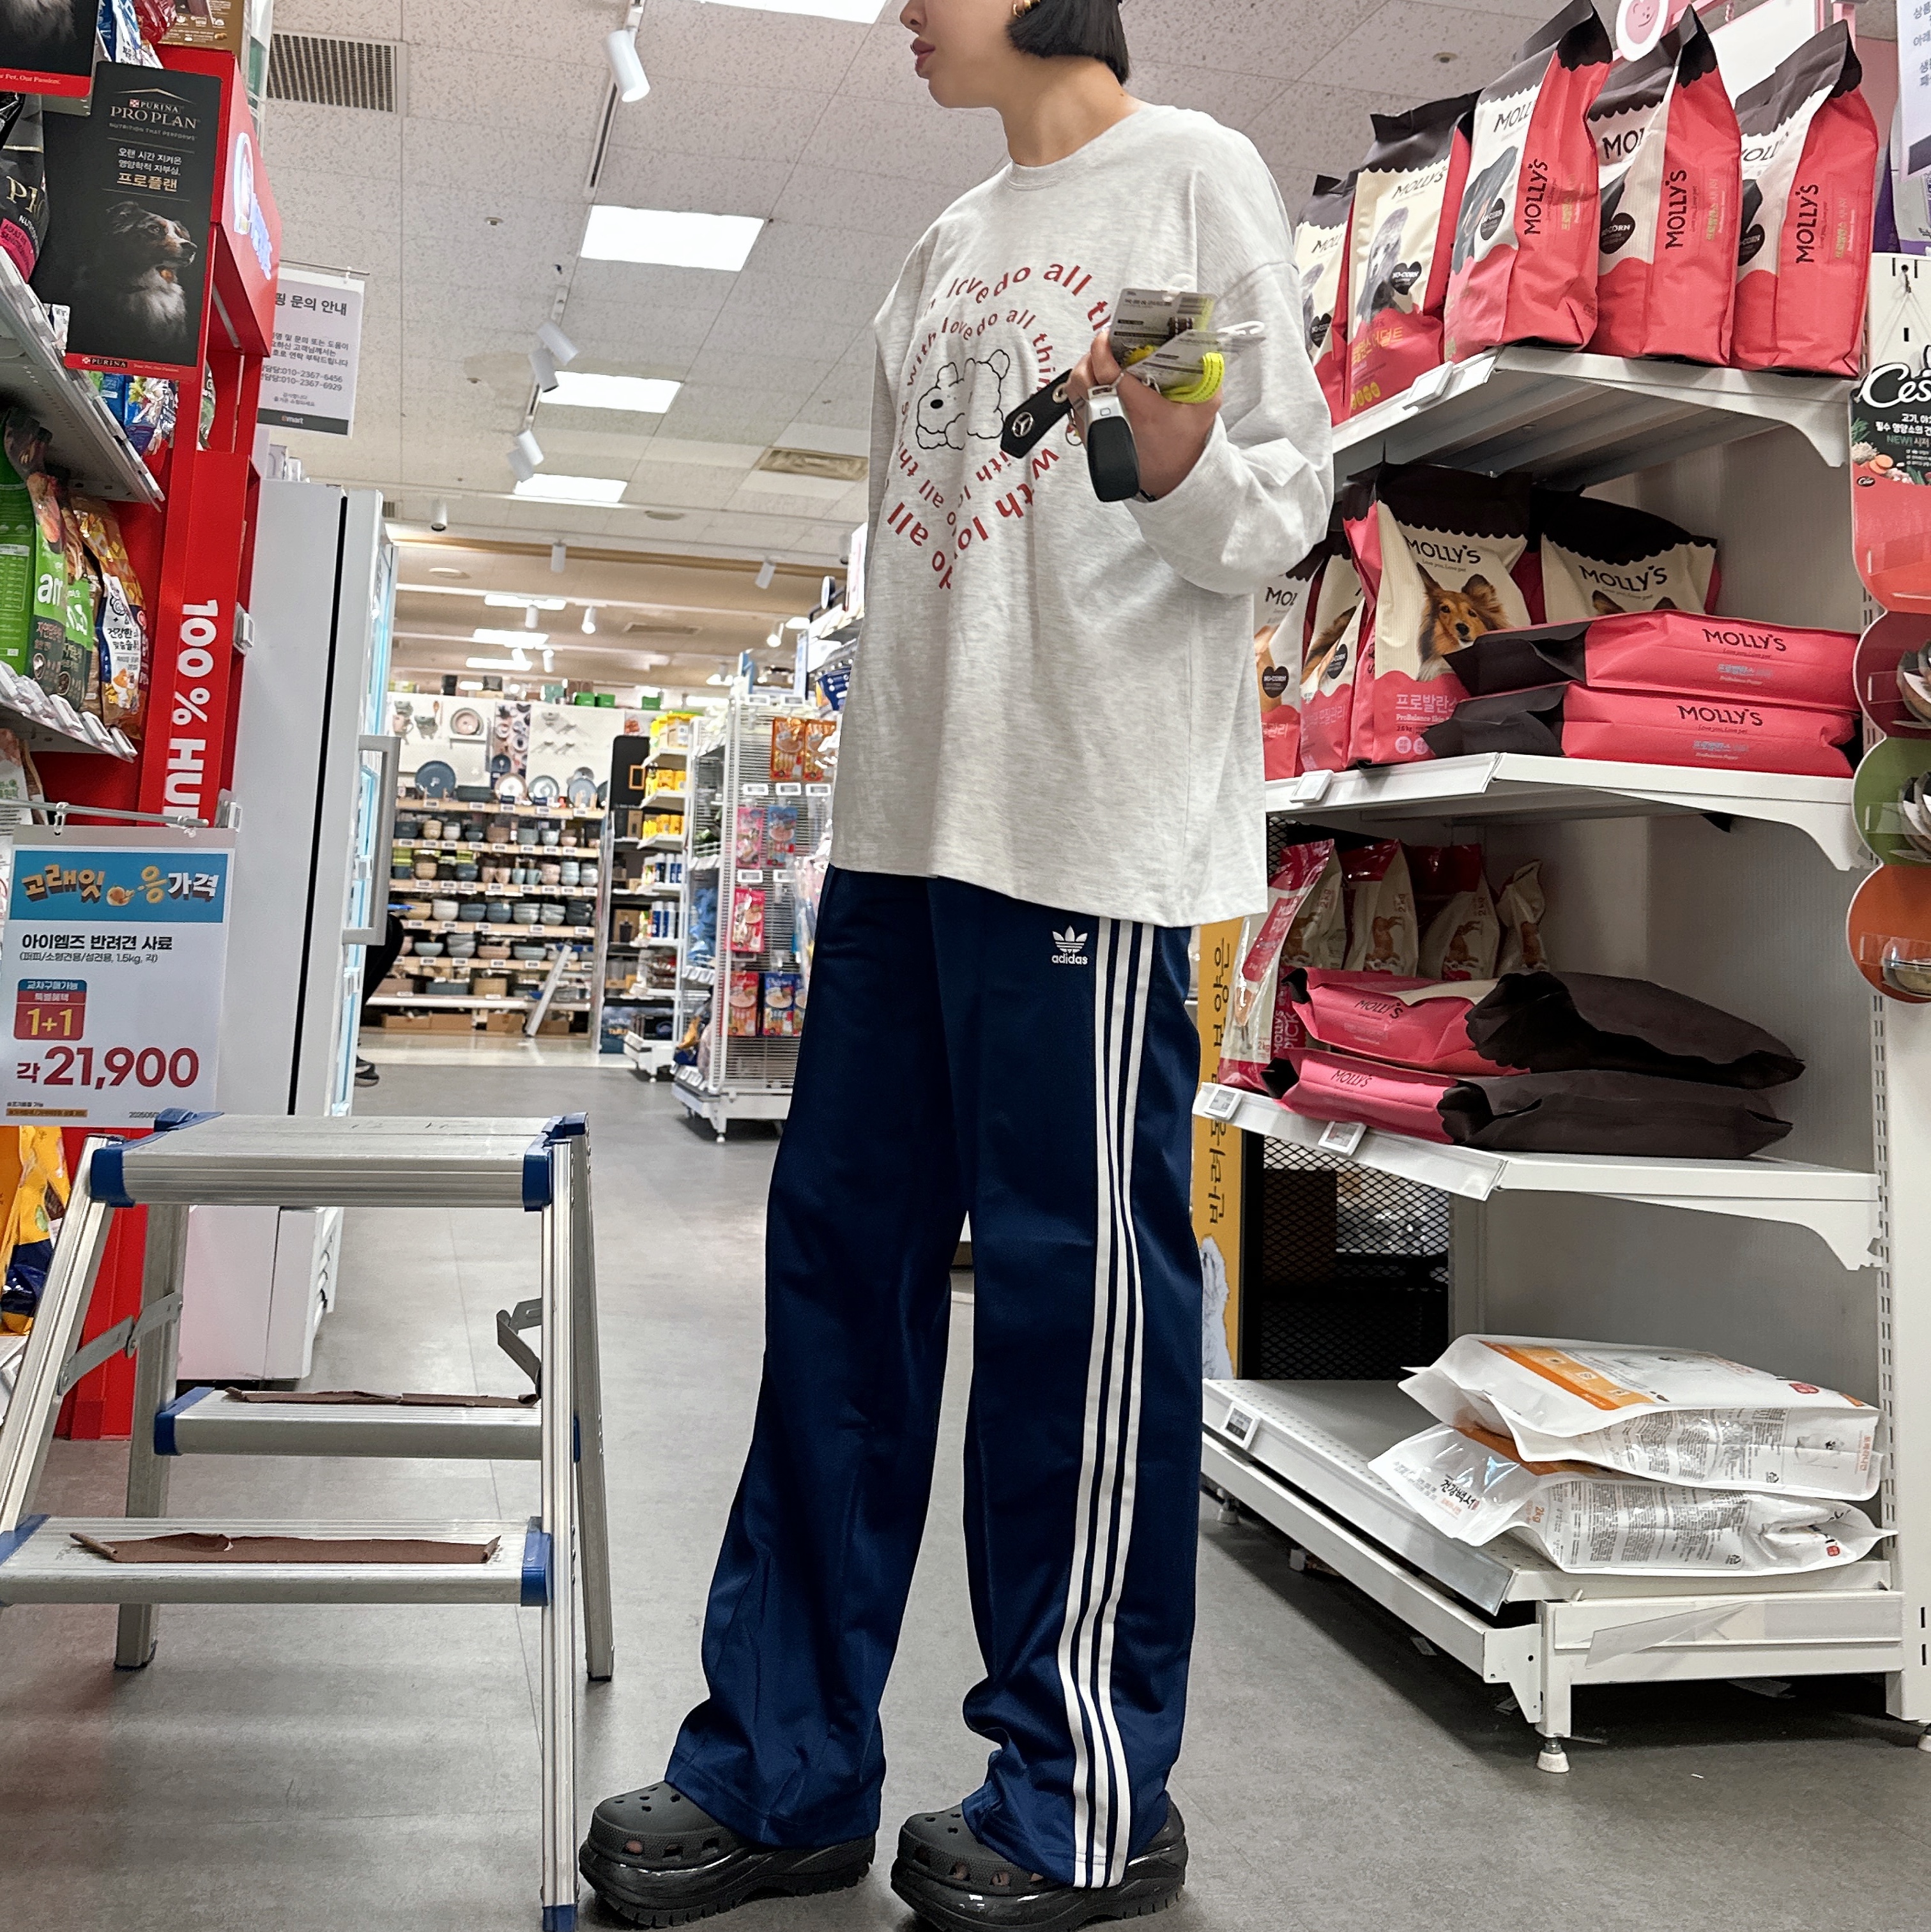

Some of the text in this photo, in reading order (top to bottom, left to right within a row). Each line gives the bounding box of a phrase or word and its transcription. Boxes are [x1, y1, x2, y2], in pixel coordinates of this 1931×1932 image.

[110, 106, 197, 130] PRO PLAN
[141, 101, 179, 114] PURINA
[137, 151, 155, 162] 시간
[116, 172, 178, 193] 프로플랜
[1523, 158, 1549, 235] MOLLY'S
[1665, 169, 1688, 250] MOLLY'S
[1795, 184, 1819, 264] MOLLY'S
[993, 266, 1032, 297] do
[1042, 263, 1093, 297] all
[289, 294, 317, 312] 문의
[321, 299, 348, 316] 안내
[975, 312, 998, 337] do
[1005, 309, 1037, 330] all
[91, 358, 127, 369] PURINA
[261, 372, 343, 392] 담당:010-2367-6929
[918, 479, 945, 509] all
[887, 501, 929, 547] all
[1403, 534, 1482, 565] MOLLY'S
[1578, 565, 1668, 592] MOLLY'S
[1702, 628, 1787, 652] MOLLY'S
[1676, 705, 1763, 726] MOLLY'S
[21, 863, 106, 903] 고래잇
[22, 934, 173, 950] 아이엠즈 반려견 사료
[1051, 952, 1088, 966] adidas
[26, 980, 79, 991] 교차구매가능
[34, 993, 70, 1002] 특별혜택
[1354, 999, 1404, 1019] MOLLY'S
[27, 1008, 73, 1037] 1+1
[17, 1046, 200, 1090] 각 21,900
[1330, 1069, 1373, 1088] MOLLY'S
